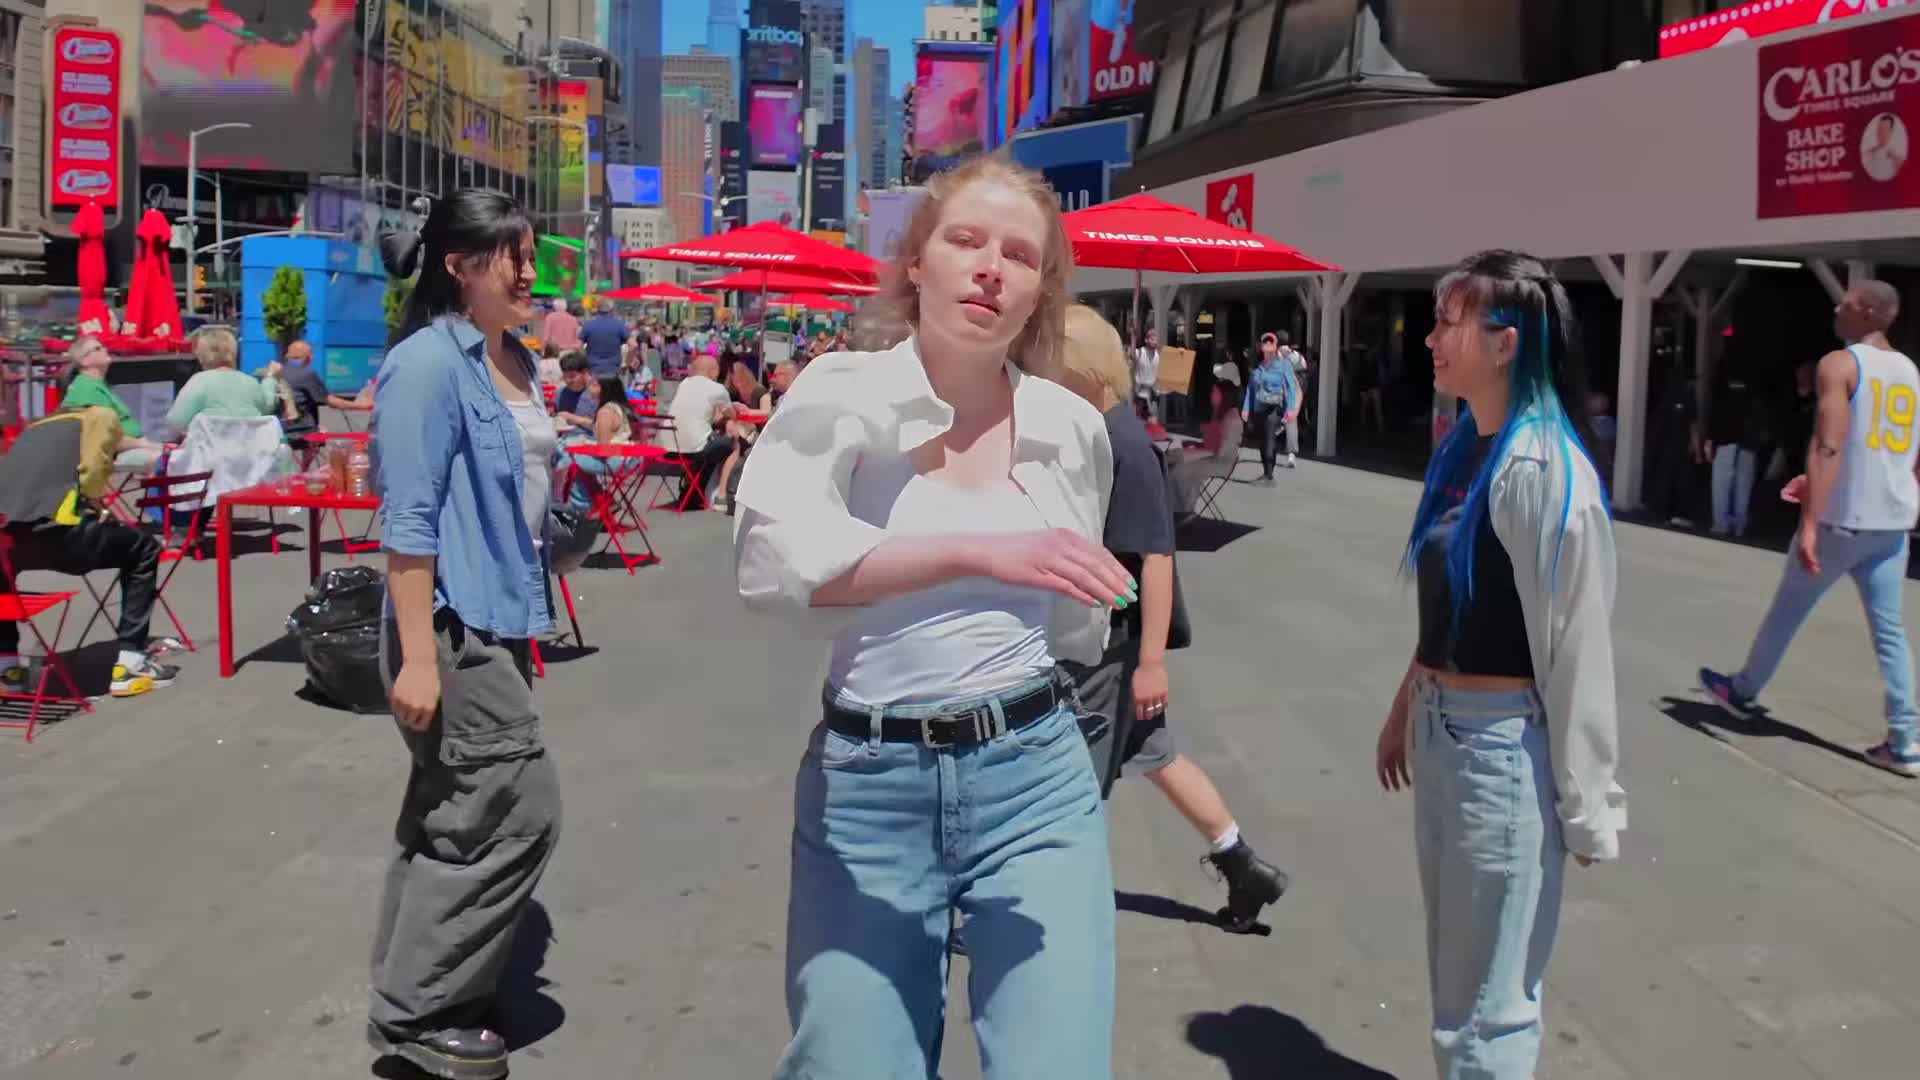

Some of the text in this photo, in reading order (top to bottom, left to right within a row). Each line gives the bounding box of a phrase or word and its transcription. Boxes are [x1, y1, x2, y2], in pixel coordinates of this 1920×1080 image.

[1095, 65, 1135, 92] OLD
[1764, 46, 1920, 122] CARLO'S
[1787, 123, 1845, 149] BAKE
[1785, 146, 1846, 171] SHOP
[1082, 231, 1264, 248] TIMES SQUARE
[667, 248, 796, 261] TIMES SQUARE
[1866, 379, 1917, 454] 19
